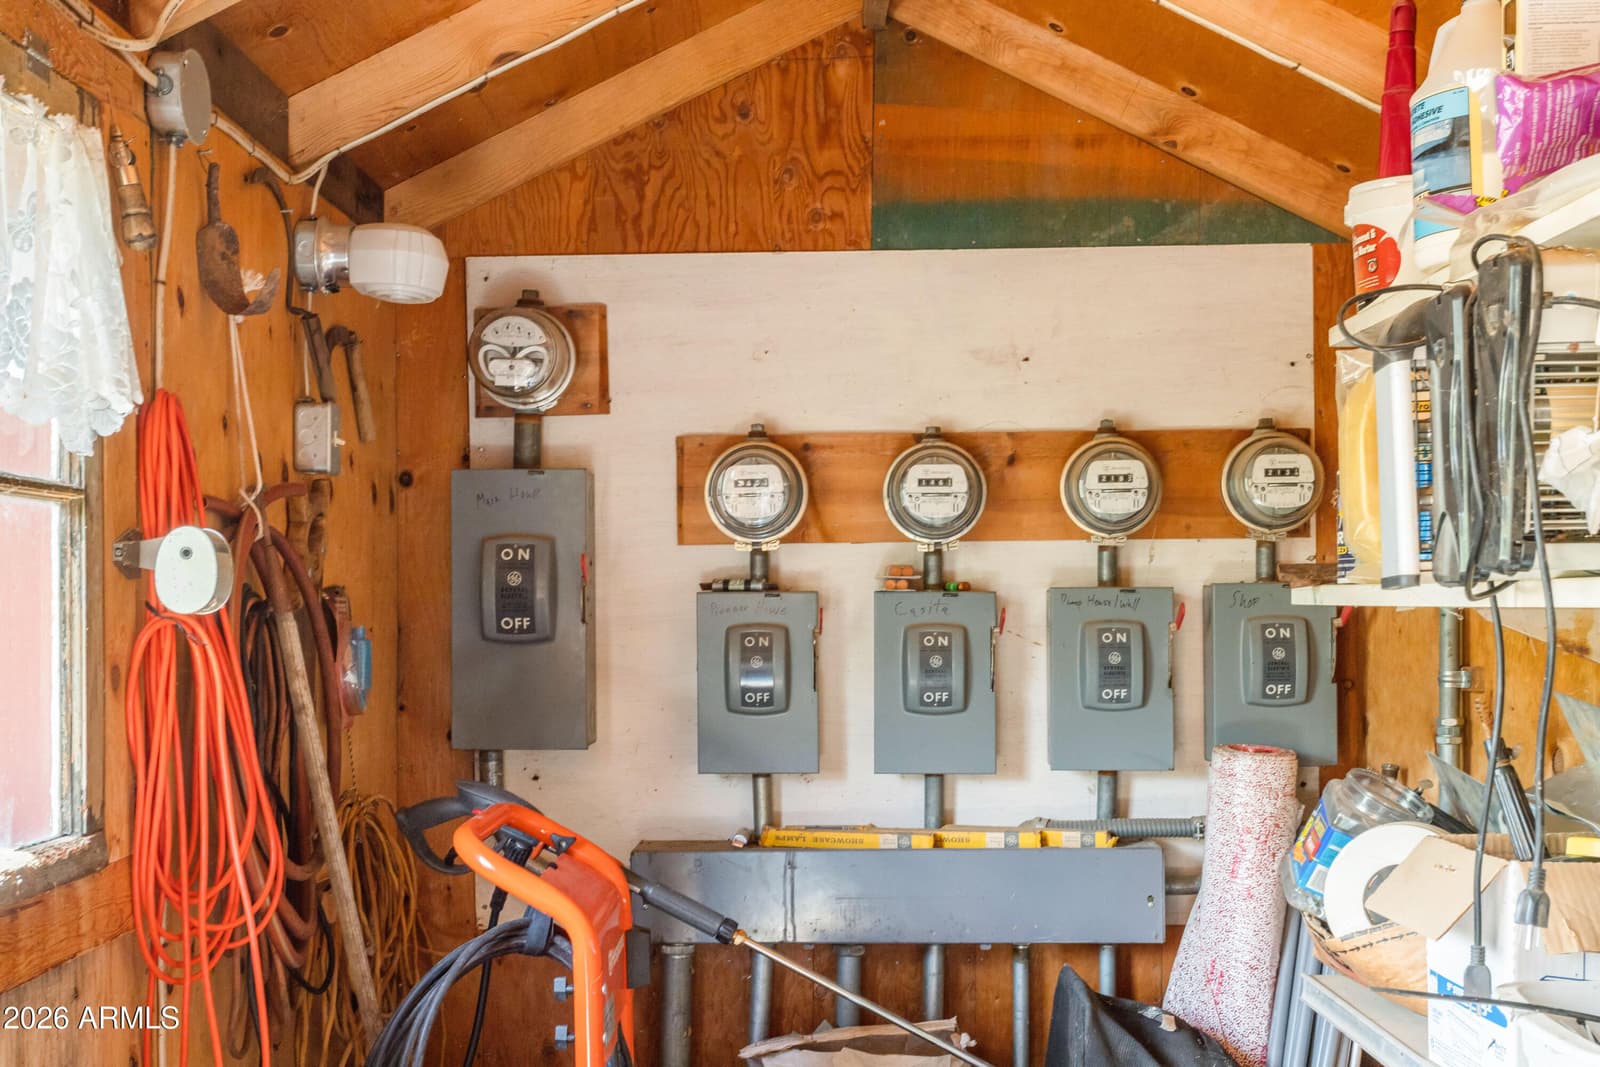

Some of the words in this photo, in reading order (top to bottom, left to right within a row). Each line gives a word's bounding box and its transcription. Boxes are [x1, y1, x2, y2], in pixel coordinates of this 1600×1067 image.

[500, 548, 531, 561] ON
[500, 617, 531, 630] OFF
[1102, 632, 1127, 643] ON
[1265, 627, 1291, 639] ON
[744, 636, 769, 648] ON
[923, 636, 949, 647] ON
[1102, 688, 1128, 700] OFF
[1265, 684, 1292, 695] OFF
[744, 692, 770, 703] OFF
[923, 692, 949, 703] OFF
